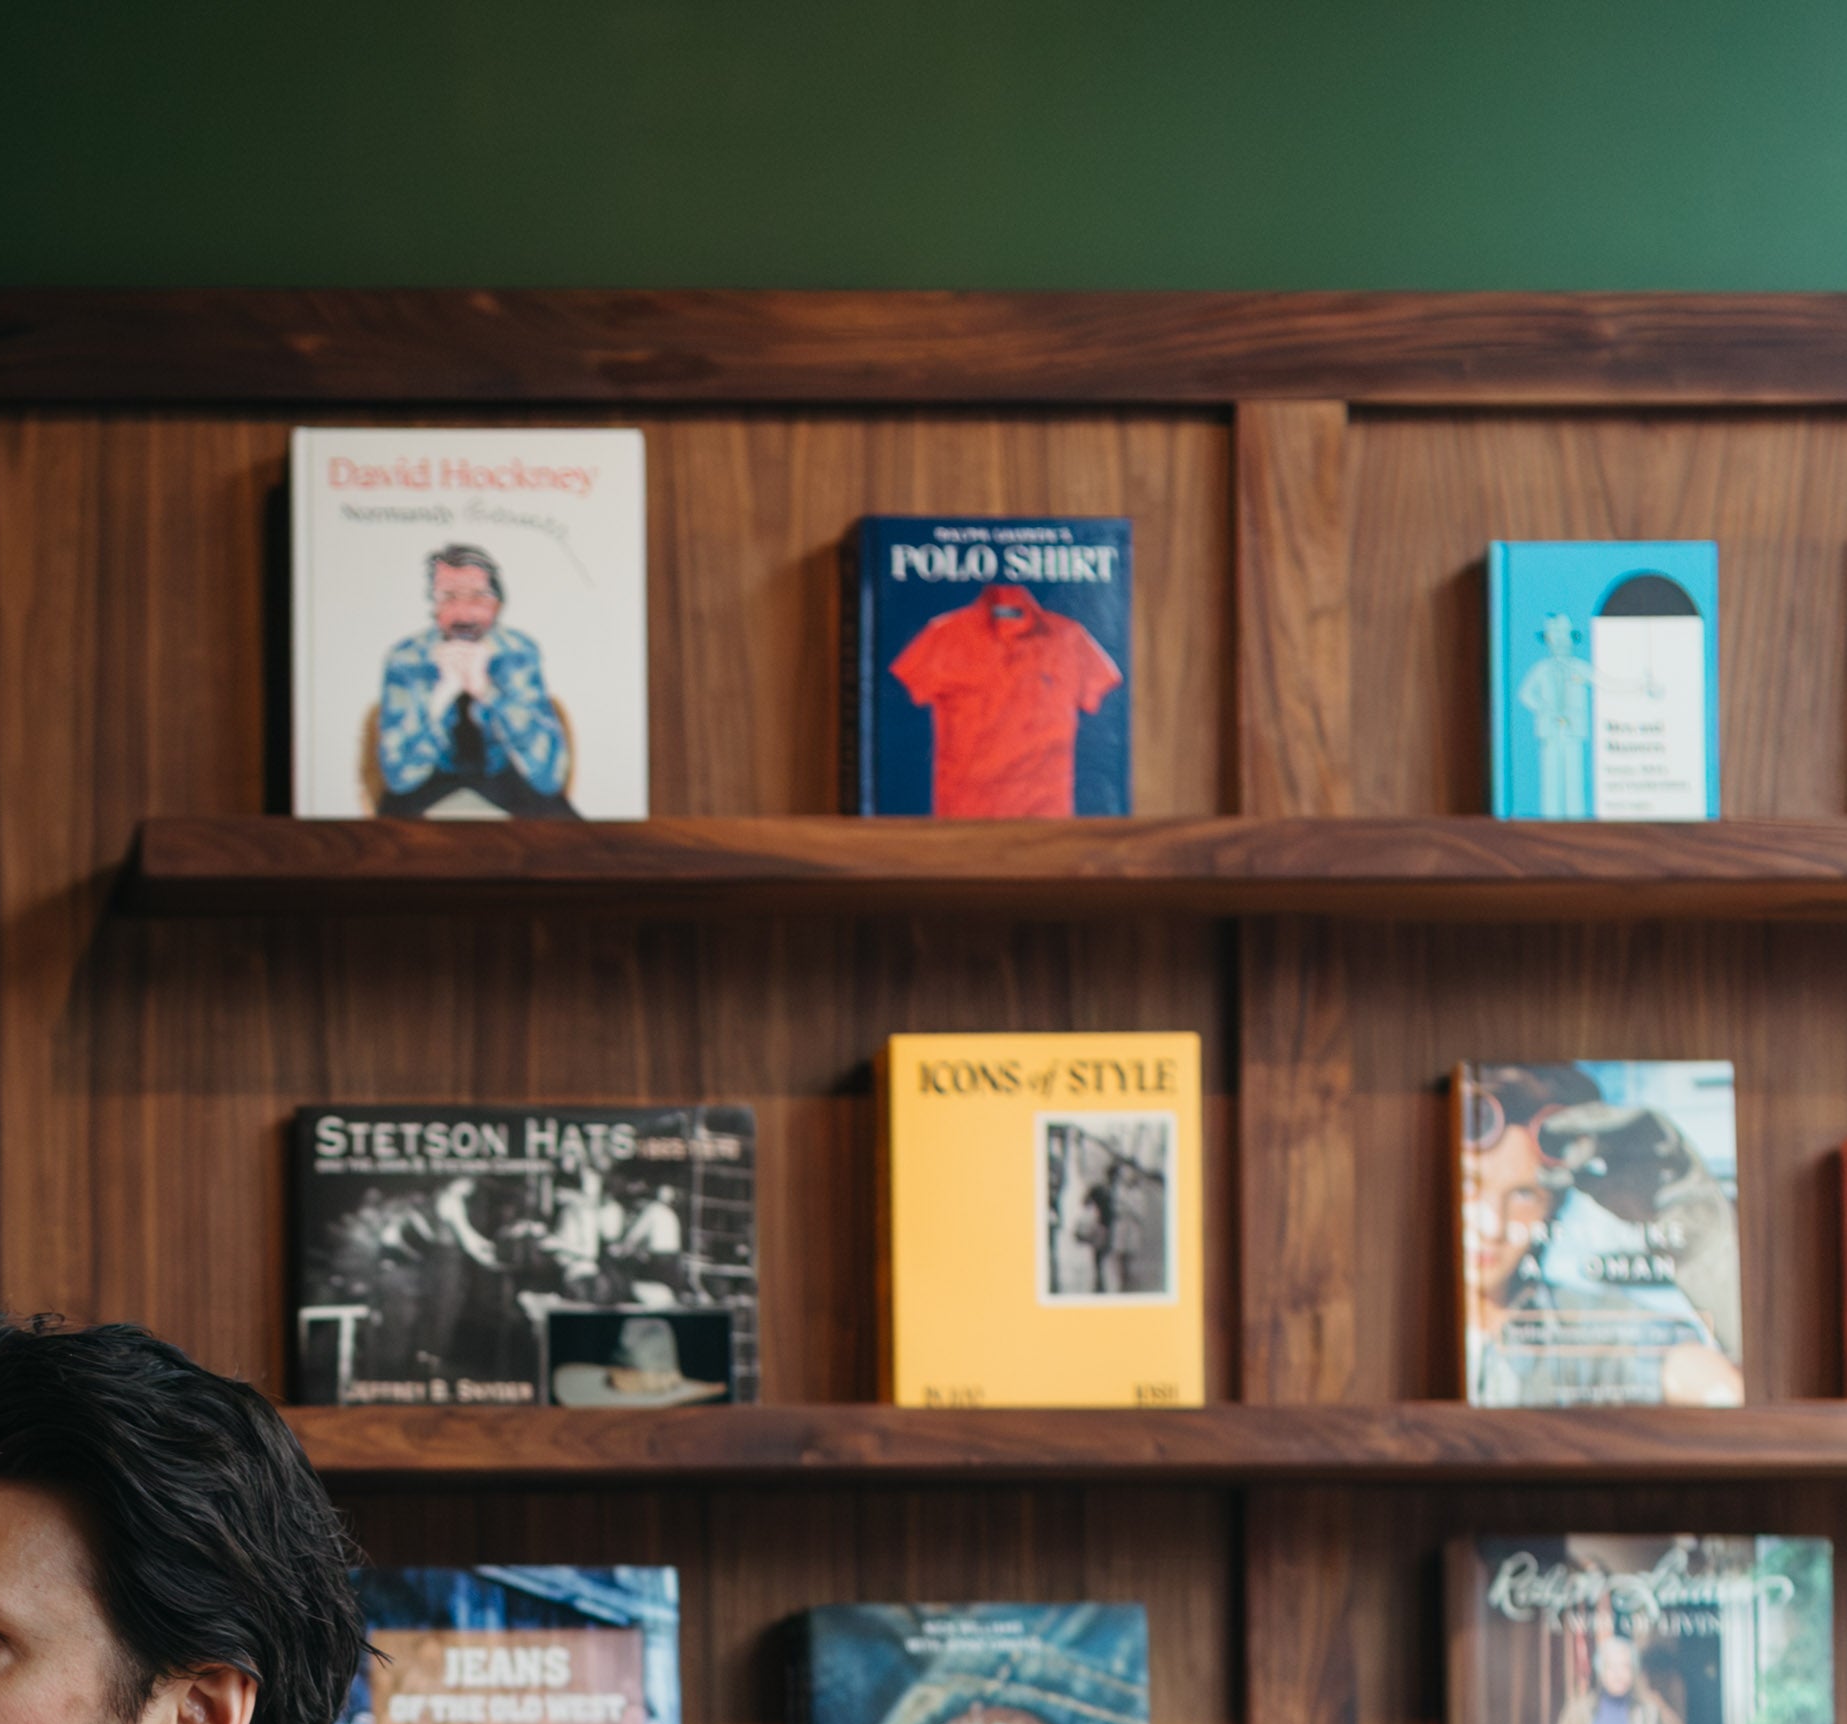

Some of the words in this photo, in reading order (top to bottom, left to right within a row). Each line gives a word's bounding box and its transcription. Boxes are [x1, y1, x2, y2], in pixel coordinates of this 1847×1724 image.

[327, 456, 431, 489] David
[440, 457, 598, 497] Hockney
[891, 543, 998, 582] POLO
[1003, 544, 1119, 583] SHIRT
[919, 1059, 1021, 1096] ICONS
[1069, 1057, 1178, 1096] STYLE
[315, 1115, 509, 1158] STETSON
[525, 1117, 637, 1160] HATS
[1564, 1254, 1676, 1282] OMAN
[1658, 1611, 1724, 1636] LIVIN
[444, 1646, 572, 1688] JEANS
[388, 1694, 424, 1723] OF
[427, 1694, 486, 1723] THE
[489, 1694, 543, 1723] OLD
[545, 1694, 627, 1723] WEST
